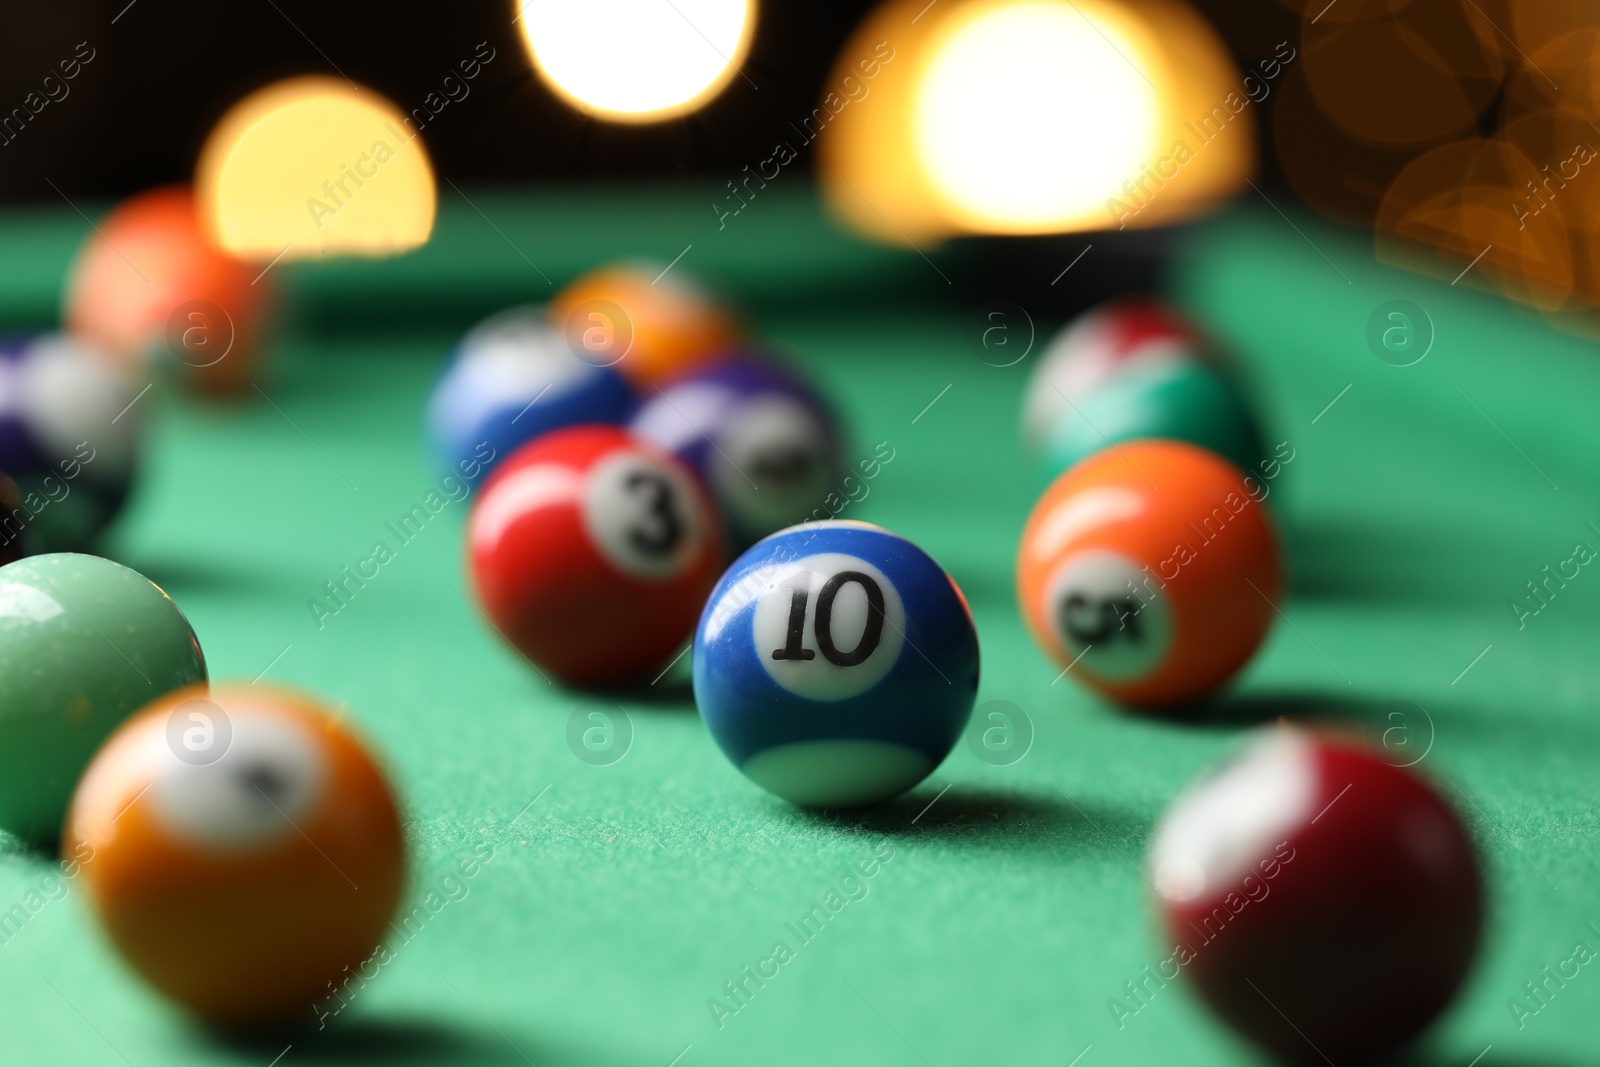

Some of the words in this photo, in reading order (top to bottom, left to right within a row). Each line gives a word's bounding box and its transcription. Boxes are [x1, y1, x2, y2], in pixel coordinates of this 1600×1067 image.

[624, 470, 683, 556] 3
[771, 570, 886, 668] 10
[1058, 591, 1143, 644] 5
